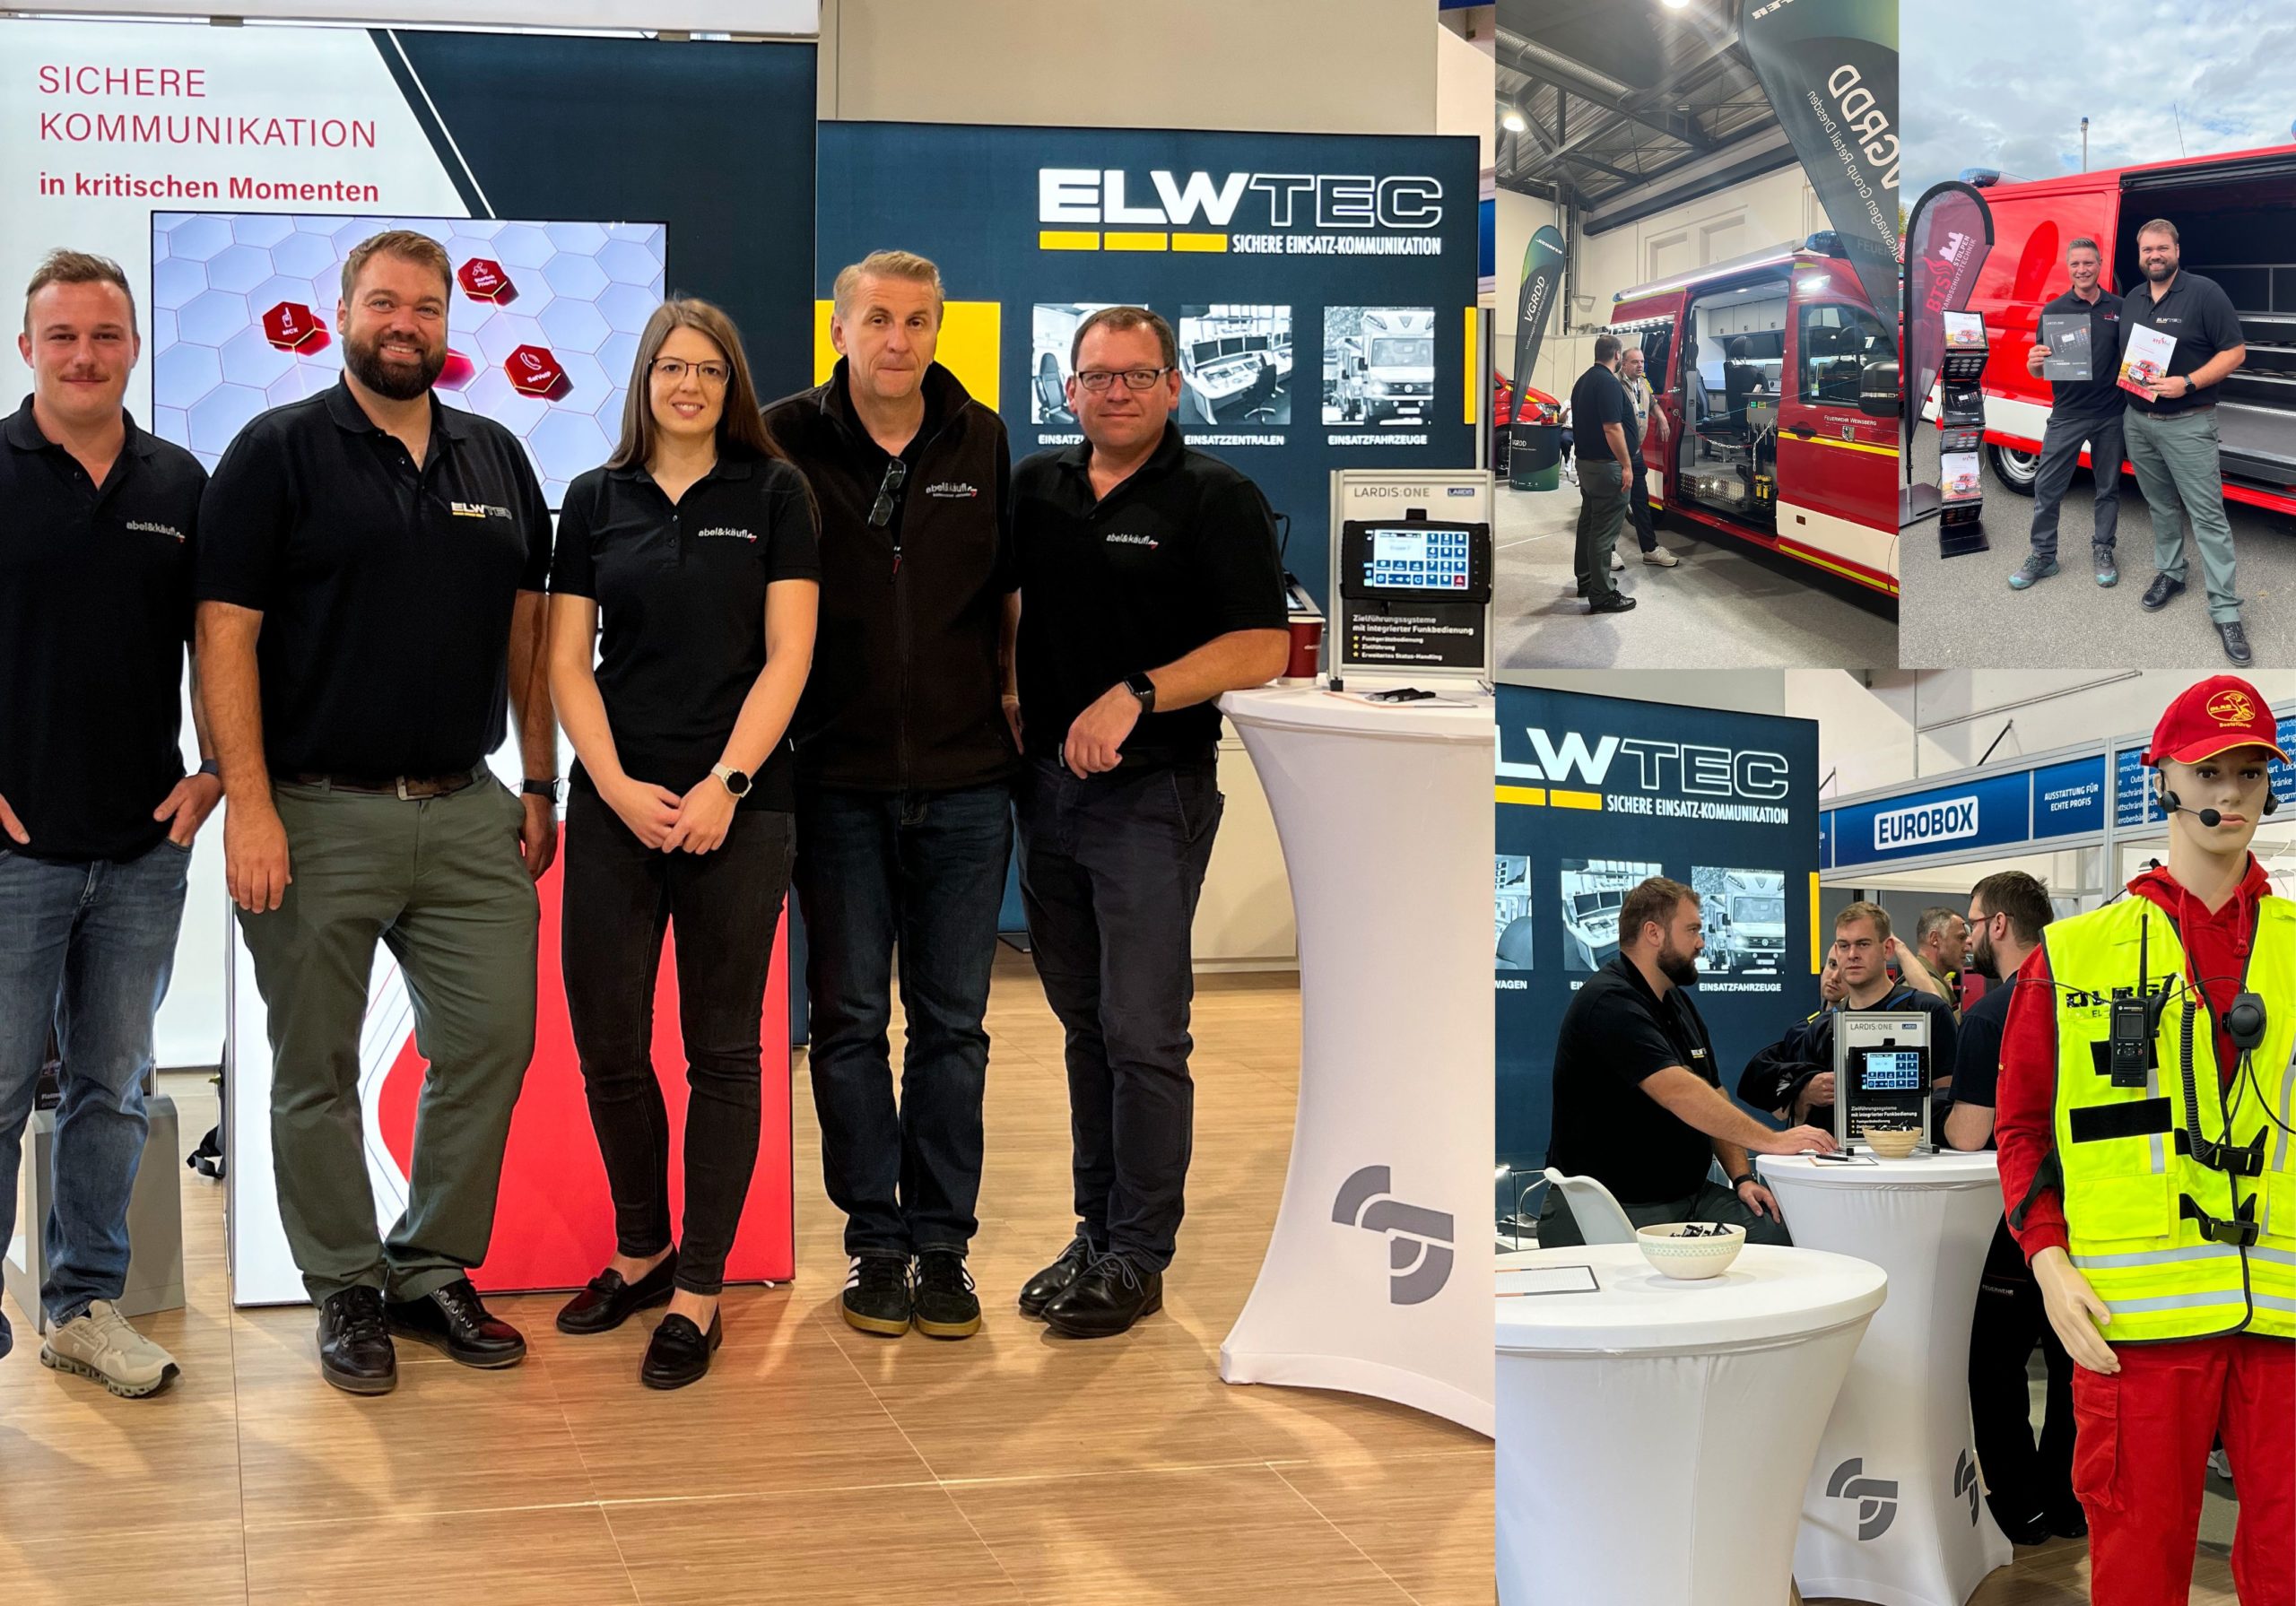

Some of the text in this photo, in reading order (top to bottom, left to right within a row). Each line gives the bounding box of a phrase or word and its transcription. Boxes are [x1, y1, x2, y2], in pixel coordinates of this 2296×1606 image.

[39, 65, 206, 97] SICHERE
[40, 112, 375, 148] KOMMUNIKATION
[40, 172, 379, 203] in kritischen Momenten
[1039, 169, 1442, 229] ELWTEC
[1232, 234, 1441, 256] SICHERE EINSATZ-KOMMUNIKATION
[1953, 235, 1970, 266] STOLPEN
[1525, 275, 1545, 322] VGRDD
[1926, 275, 1952, 312] BTS
[1184, 435, 1284, 446] EINSATZZENTRALEN
[1327, 435, 1428, 447] EINSATZFAHRZEUGE
[1354, 487, 1430, 498] LARDIS:ONE
[1352, 614, 1436, 624] Zielführungssysteme
[1367, 624, 1411, 634] integrierter
[1413, 626, 1474, 636] Funkbedienung
[2044, 782, 2099, 801] AUSSTATTUNG FÜR
[2050, 797, 2092, 812] ECHTE PROFIS
[1607, 794, 1788, 824] SICHERE EINSATZ-KOMMUNIKATION
[1879, 803, 1974, 845] EUROBOX
[1699, 983, 1781, 992] EINSATZFAHRZEUGE
